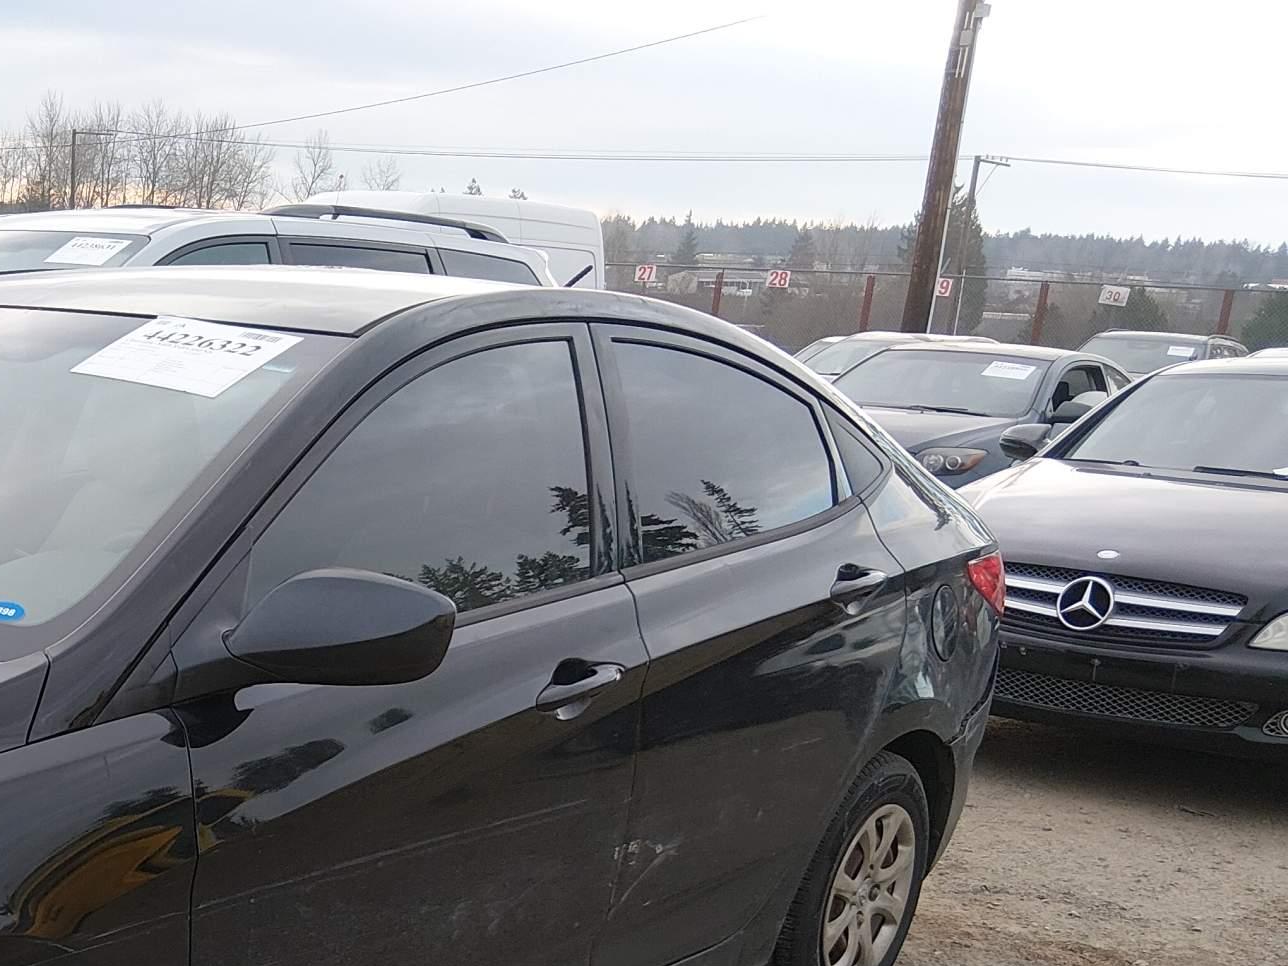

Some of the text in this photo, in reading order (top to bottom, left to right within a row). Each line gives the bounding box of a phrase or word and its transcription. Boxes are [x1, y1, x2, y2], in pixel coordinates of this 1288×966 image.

[637, 266, 654, 282] 27
[768, 271, 788, 287] 28
[937, 278, 950, 295] 9
[1105, 290, 1121, 302] 30
[143, 329, 263, 357] 44226322
